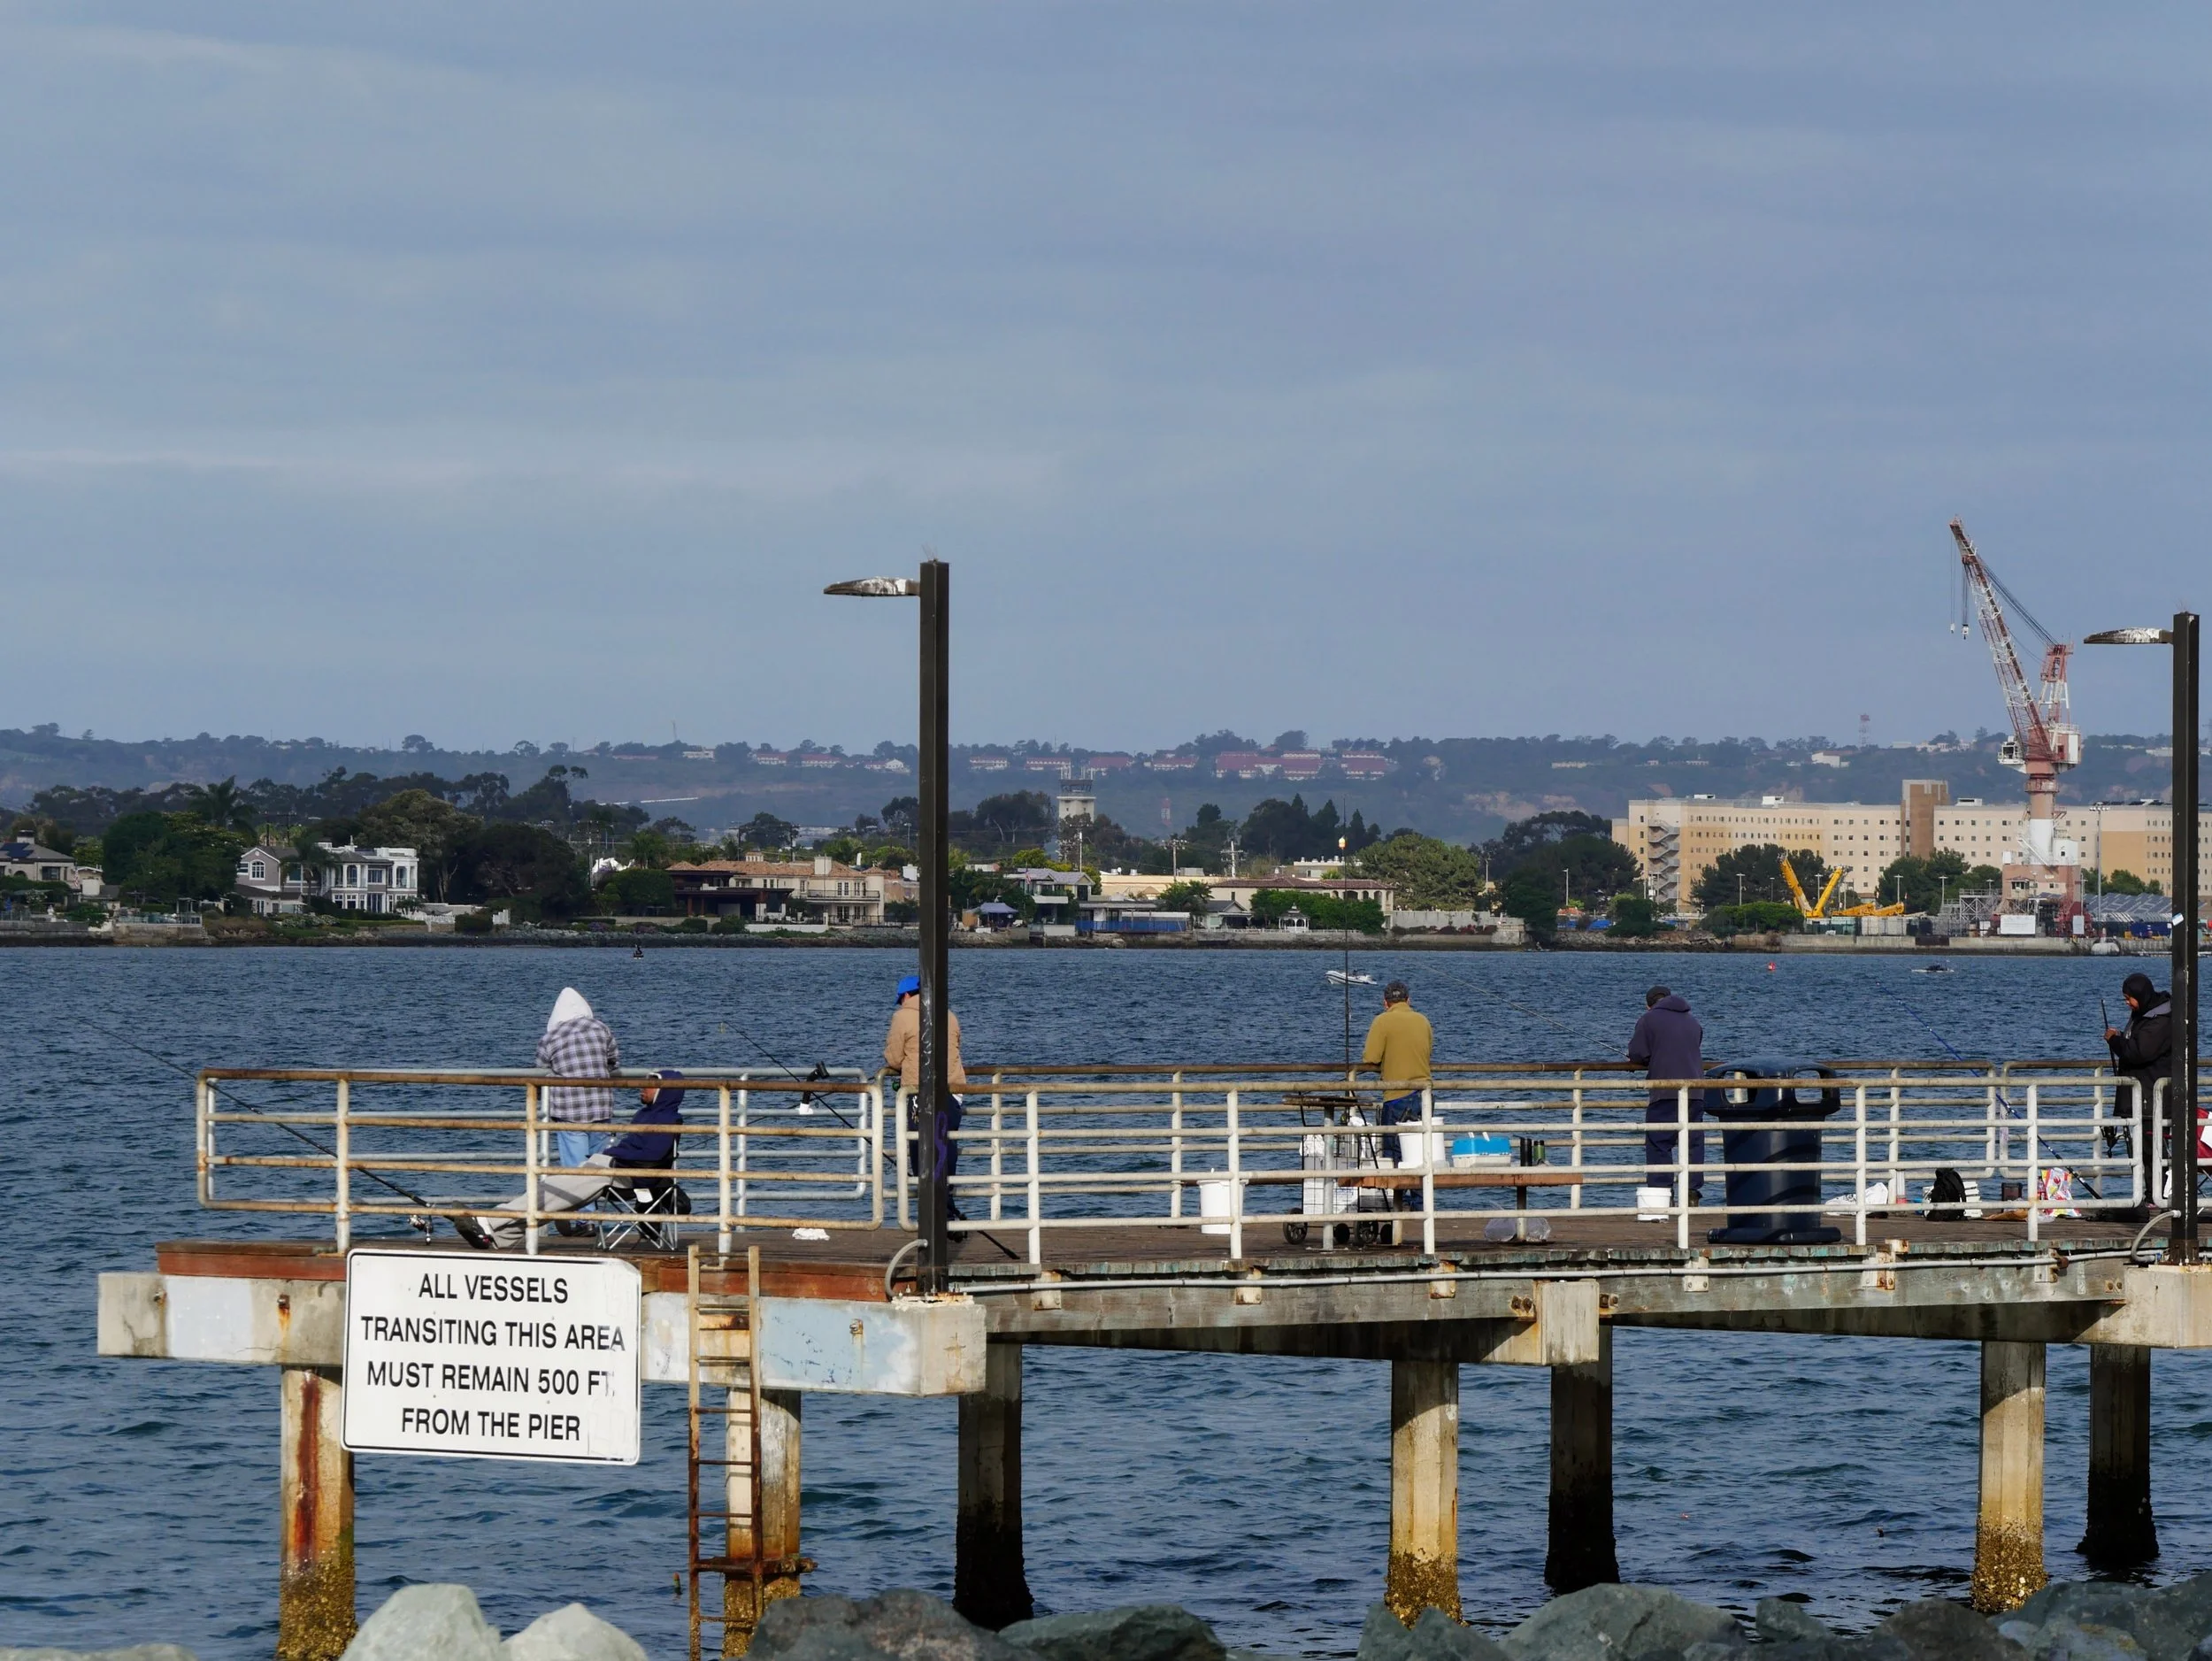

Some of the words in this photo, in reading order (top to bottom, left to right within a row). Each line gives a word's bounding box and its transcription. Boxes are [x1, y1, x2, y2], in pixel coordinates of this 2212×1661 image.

[419, 1273, 457, 1299] ALL
[465, 1274, 568, 1304] VESSELS
[360, 1315, 496, 1347] TRANSITING
[504, 1321, 557, 1349] THIS
[564, 1324, 626, 1351] AREA
[367, 1360, 434, 1388] MUST
[442, 1364, 529, 1393] REMAIN
[538, 1368, 580, 1396] 500
[402, 1407, 470, 1436] FROM
[477, 1411, 520, 1438] THE
[528, 1413, 580, 1442] PIER
